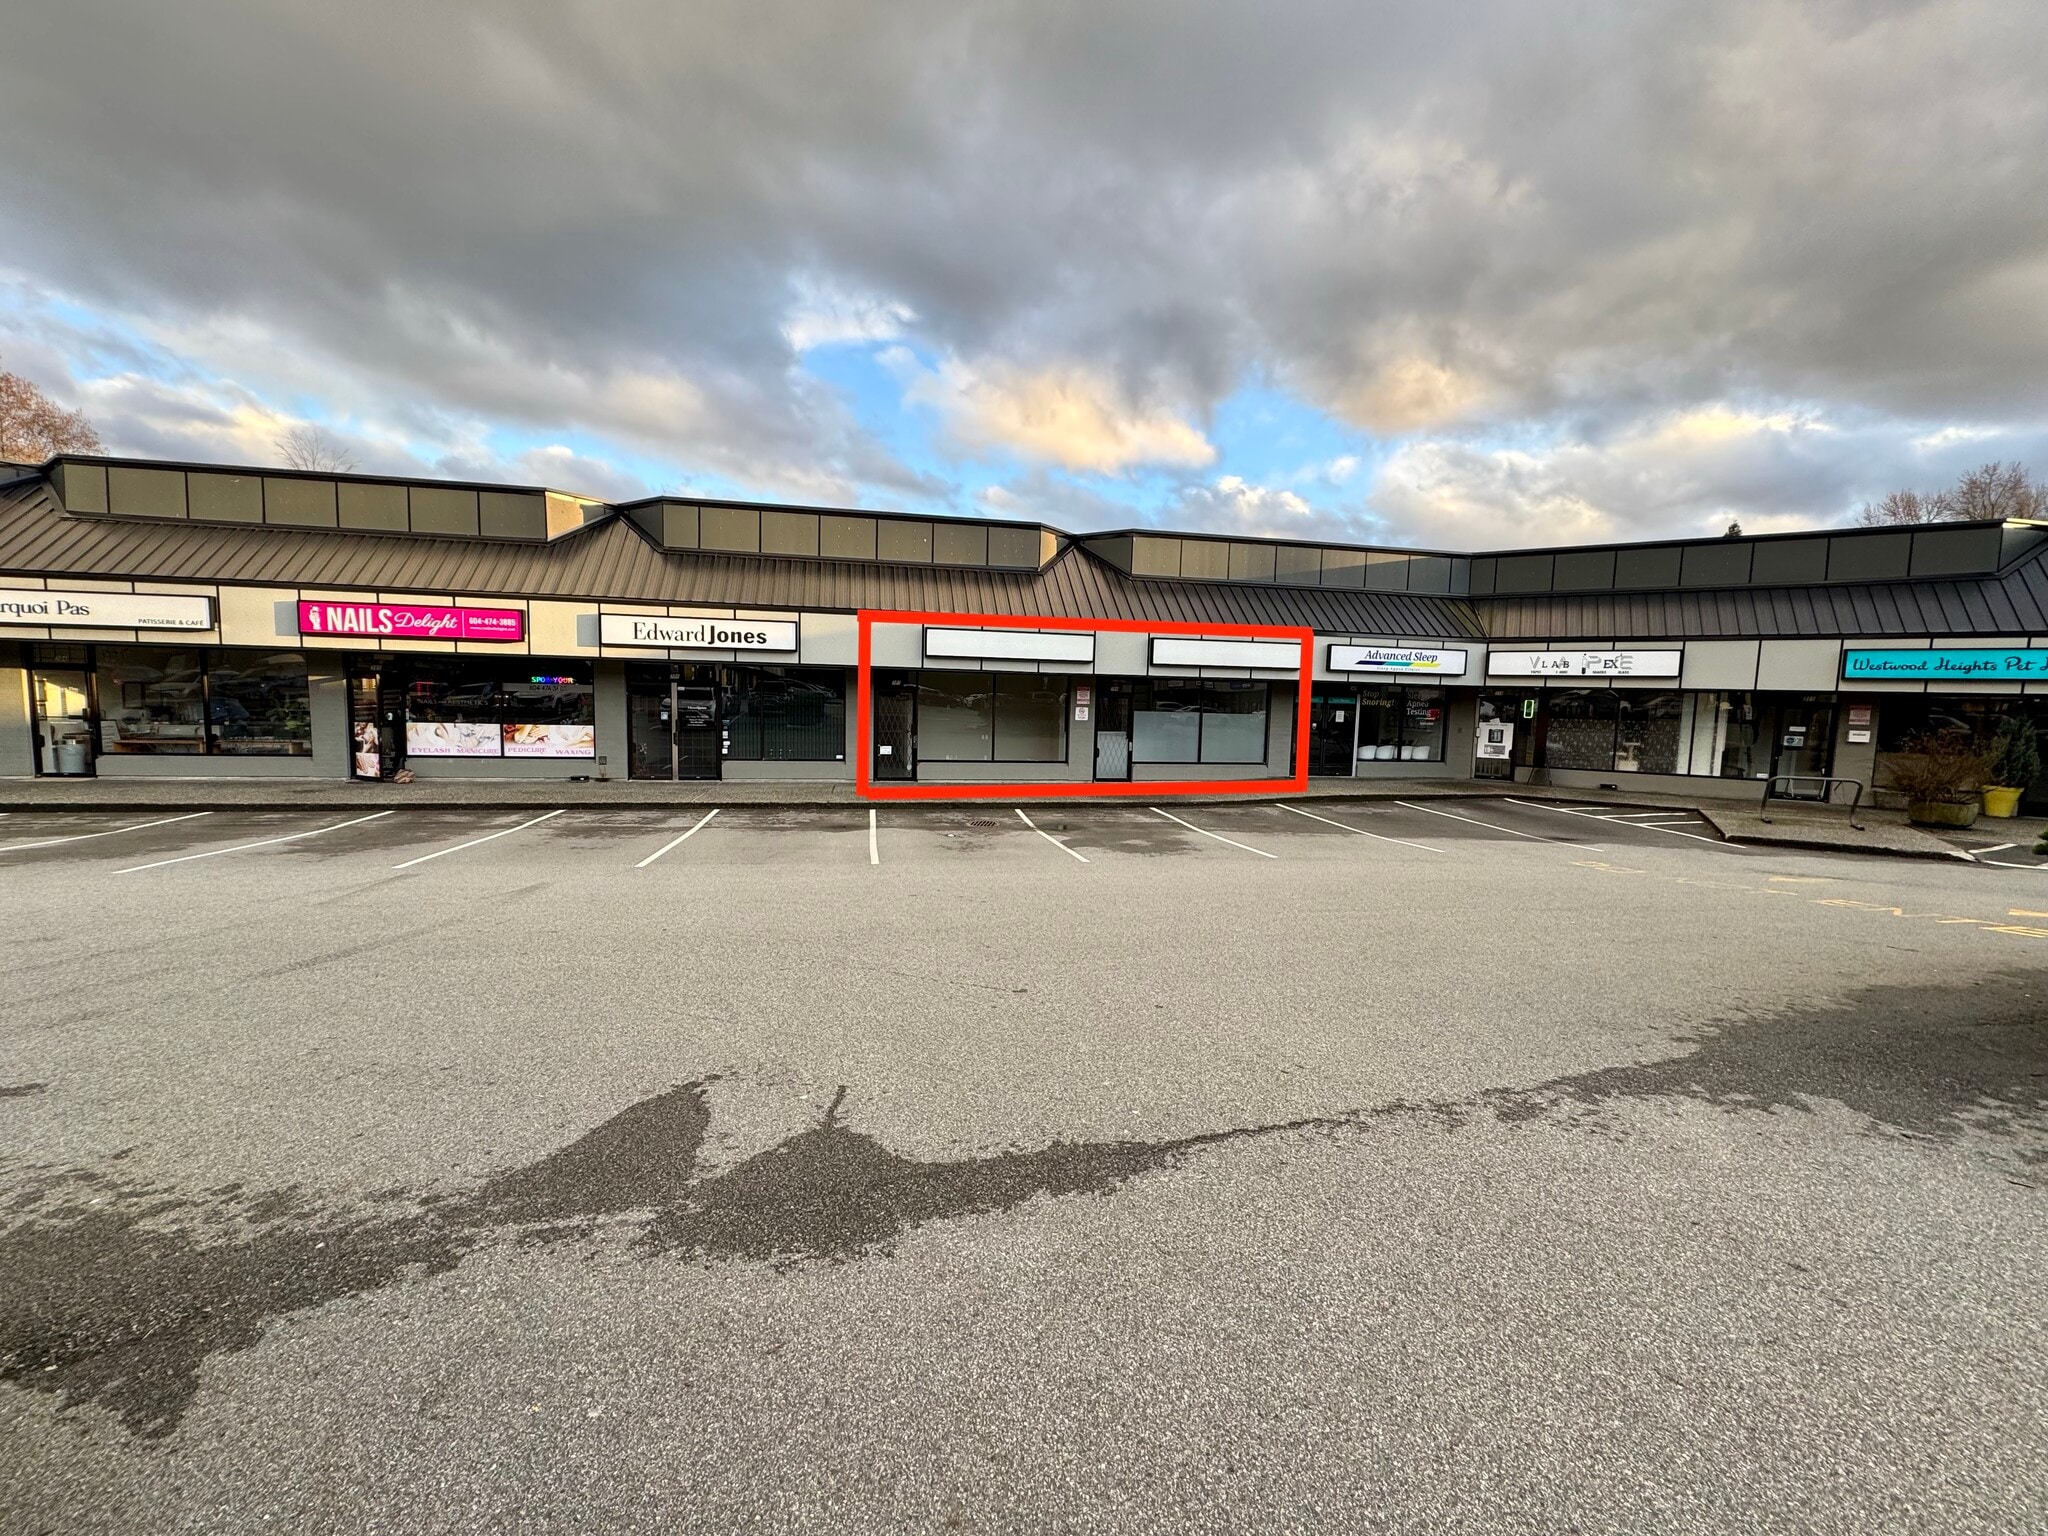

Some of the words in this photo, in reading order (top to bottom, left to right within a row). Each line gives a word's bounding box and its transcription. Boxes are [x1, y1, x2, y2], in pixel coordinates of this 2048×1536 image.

[57, 600, 90, 616] Pas
[326, 607, 393, 633] NAILS
[394, 612, 457, 635] Delight
[632, 622, 705, 642] Edward
[707, 625, 768, 645] Jones
[1364, 650, 1412, 661] Advanced
[1413, 652, 1438, 663] Sleep
[1853, 657, 1928, 671] Westwood
[1934, 656, 1997, 674] Heights
[2004, 656, 2038, 671] Pet
[1362, 689, 1380, 699] Stop
[1361, 697, 1395, 708] Snoring!
[1406, 699, 1429, 708] Apnea
[1405, 707, 1432, 717] Testing
